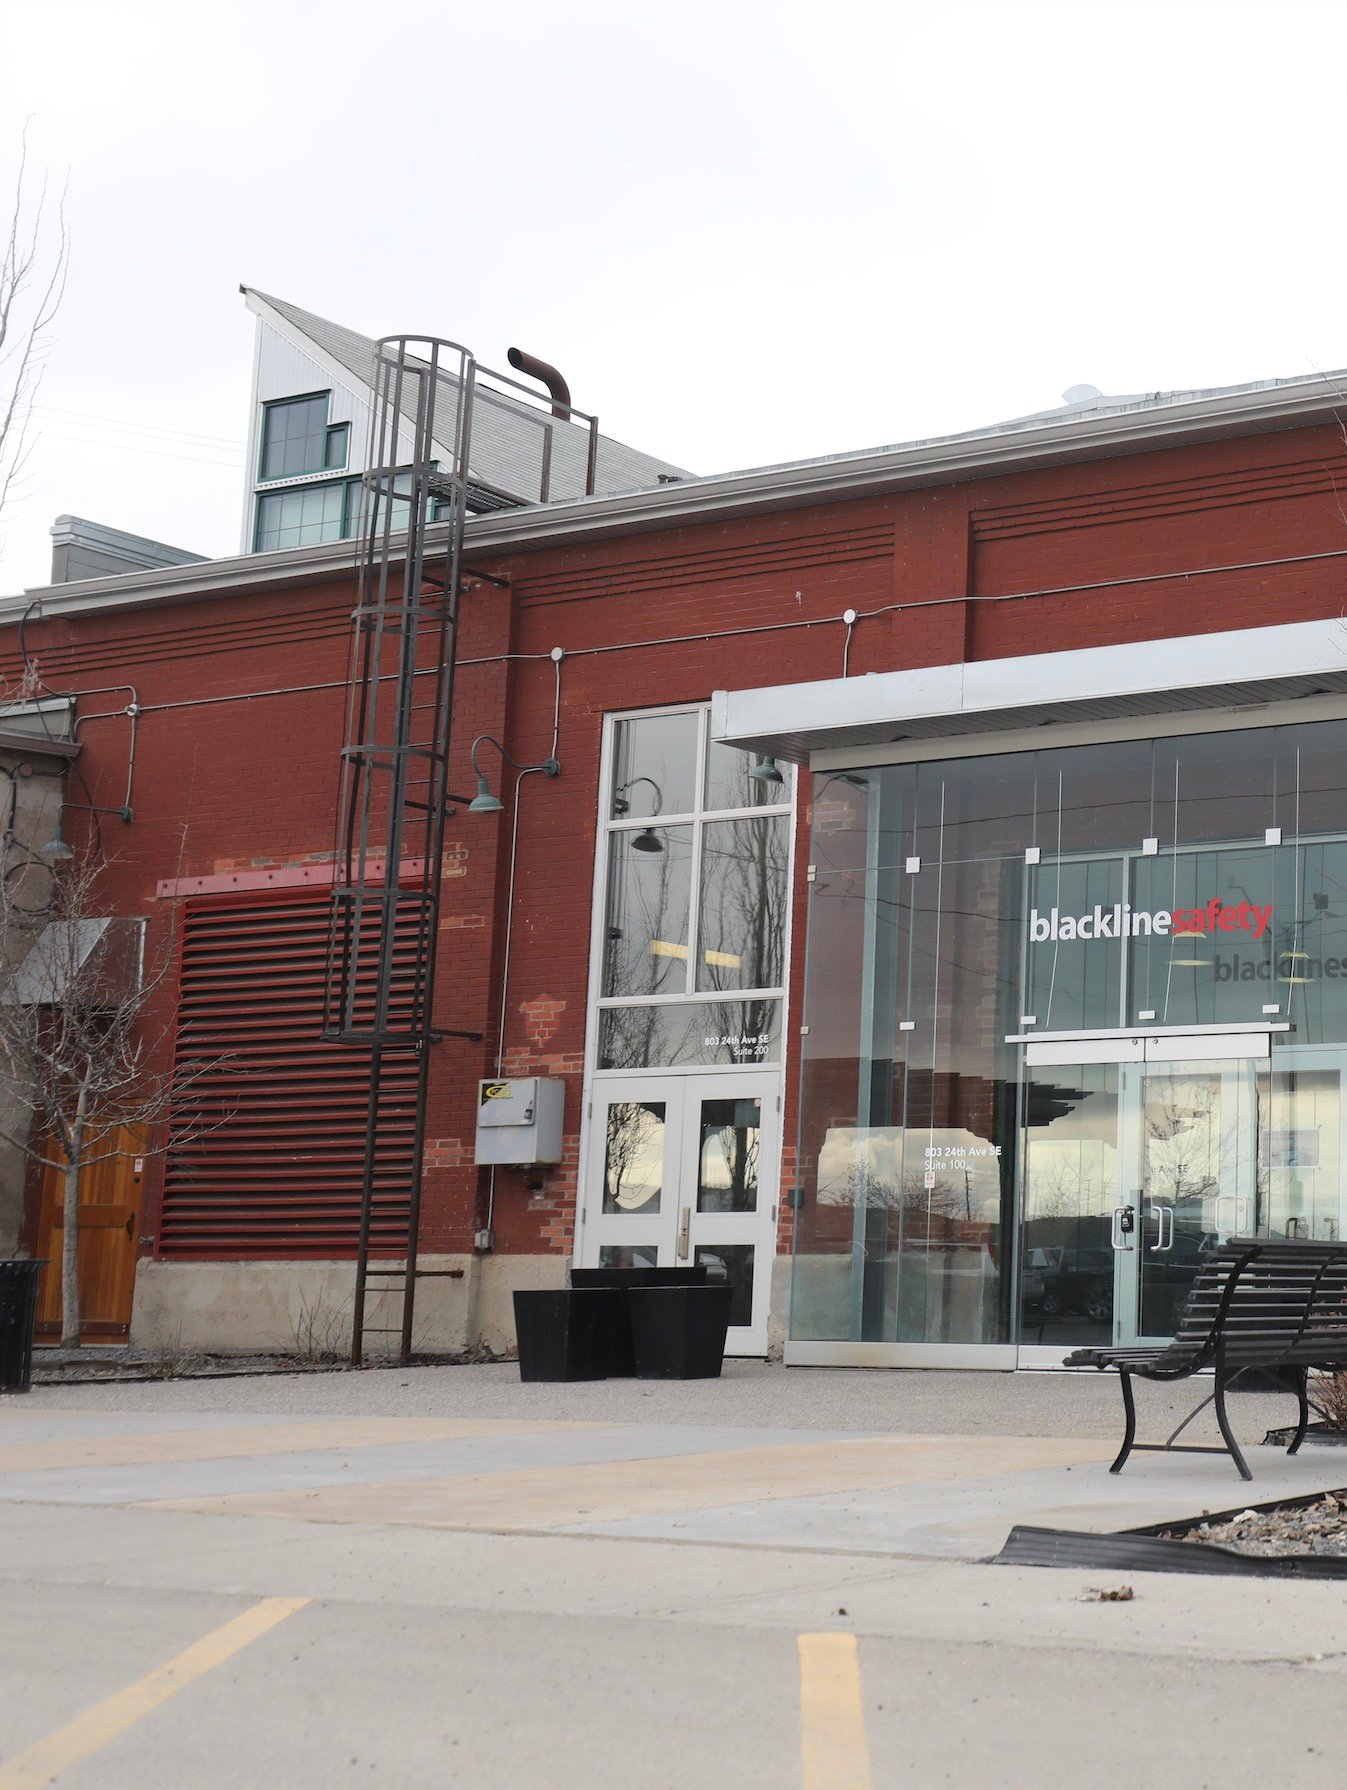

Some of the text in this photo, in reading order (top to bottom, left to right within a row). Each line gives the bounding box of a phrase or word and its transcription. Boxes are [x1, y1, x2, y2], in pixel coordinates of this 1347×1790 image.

[705, 1034, 769, 1046] 803 24th Ave SE
[733, 1046, 769, 1055] Suite 200
[924, 1145, 1002, 1158] 803 24th Ave SE
[924, 1159, 966, 1170] Suite 100
